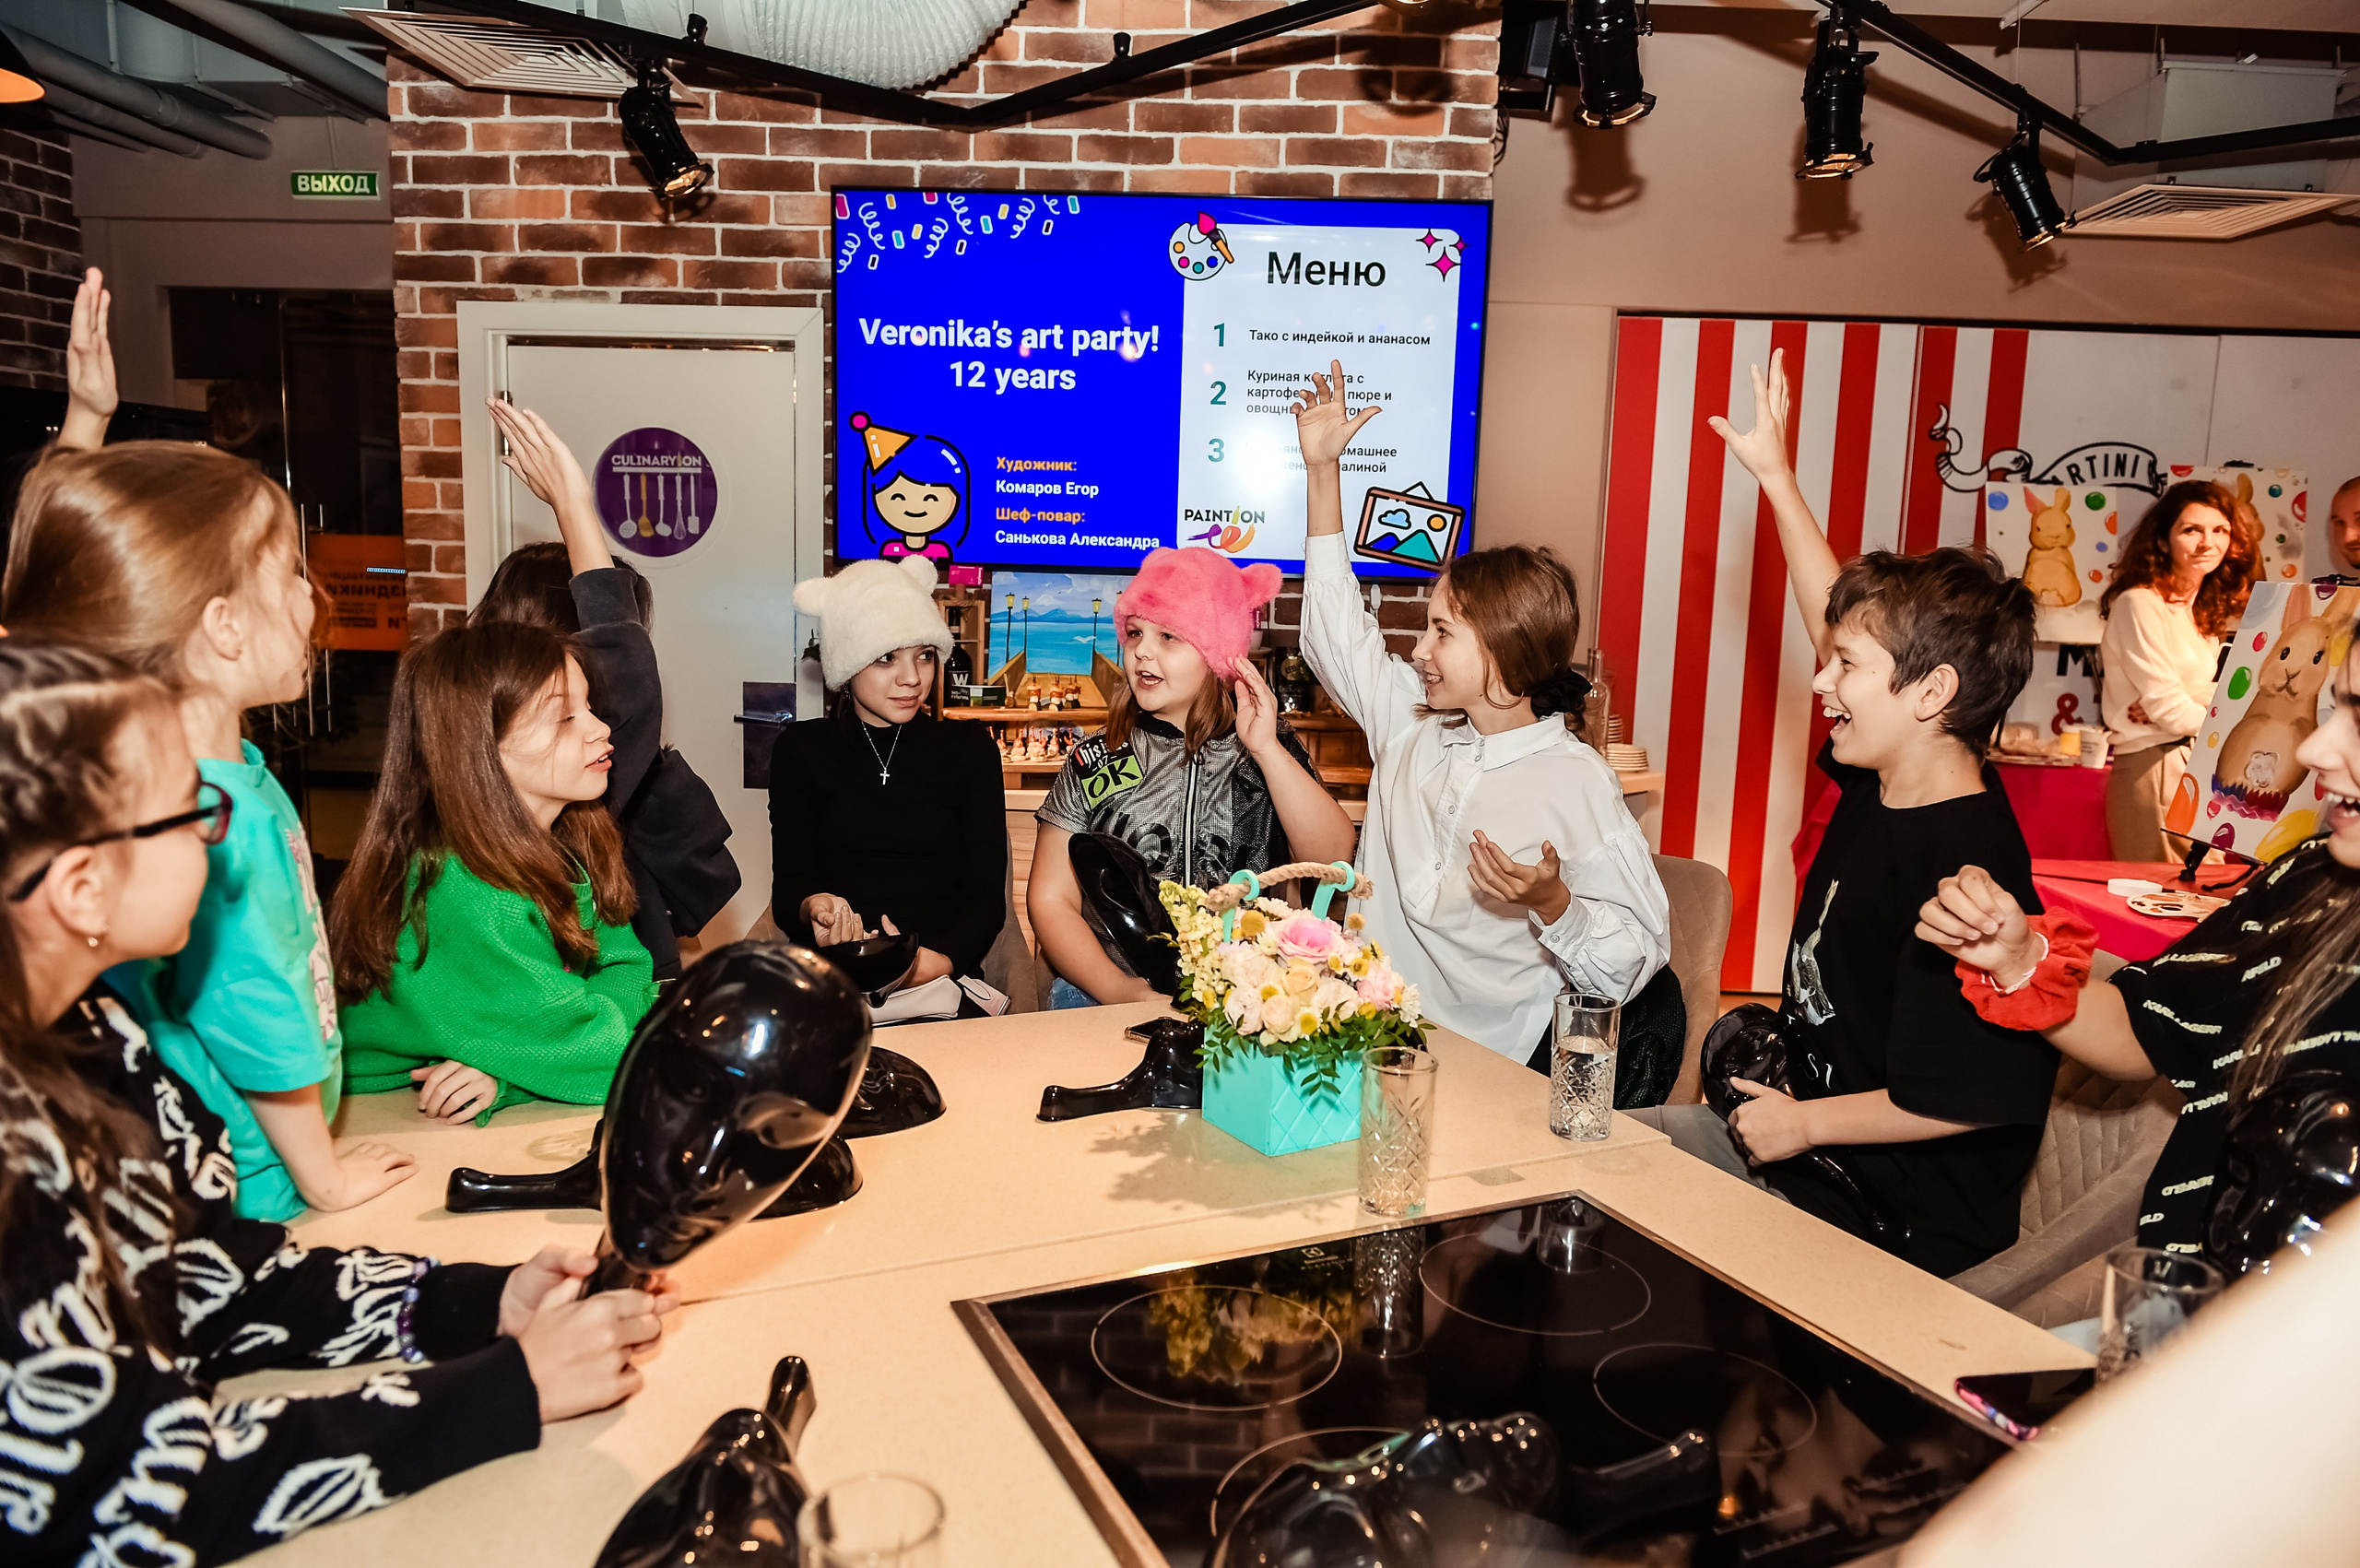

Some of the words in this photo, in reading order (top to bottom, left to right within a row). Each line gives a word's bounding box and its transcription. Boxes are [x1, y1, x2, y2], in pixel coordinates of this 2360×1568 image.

[297, 174, 371, 194] ВЫХОД
[1268, 252, 1386, 287] Меню
[1021, 324, 1064, 349] art
[1072, 324, 1160, 359] party!
[1214, 323, 1224, 347] 1
[1248, 329, 1279, 341] Тако
[1281, 332, 1290, 342] с
[1292, 331, 1353, 344] индейкой
[1358, 335, 1364, 343] и
[1368, 335, 1431, 346] ананасом
[950, 361, 985, 387] 12
[995, 368, 1076, 395] years
[1247, 370, 1300, 383] Куриная
[1210, 381, 1226, 405] 2
[1347, 391, 1382, 404] пюре
[1384, 392, 1393, 401] и
[1208, 439, 1223, 462] 3
[1340, 446, 1398, 457] омашнее
[997, 457, 1077, 472] Художник:
[1340, 461, 1387, 473] алиной
[2054, 453, 2140, 485] RTINI
[997, 480, 1061, 497] Комаров
[1066, 482, 1100, 499] Егор
[997, 508, 1085, 525] Шеф-повар:
[996, 530, 1066, 545] Санькова
[1070, 533, 1160, 550] Александра
[1088, 758, 1139, 798] OK
